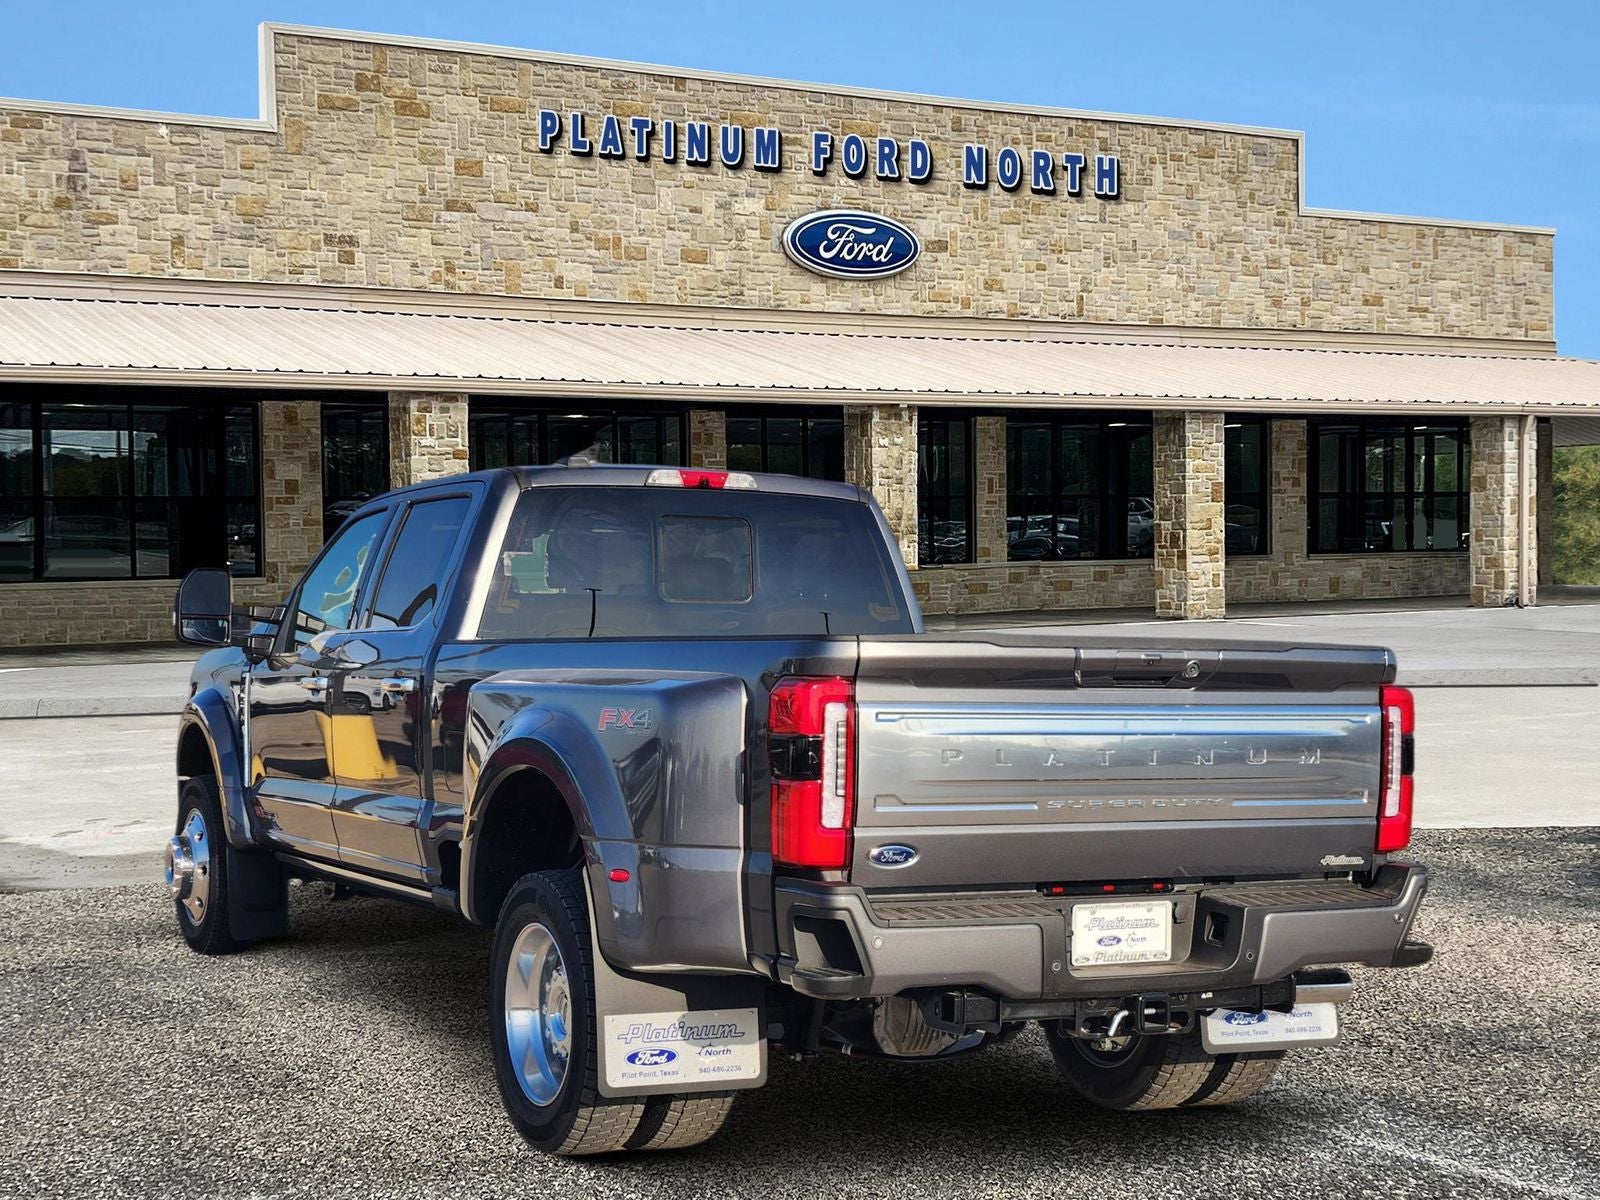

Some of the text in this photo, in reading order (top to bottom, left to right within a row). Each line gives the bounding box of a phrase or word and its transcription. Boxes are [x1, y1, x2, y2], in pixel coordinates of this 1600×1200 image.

[538, 108, 1121, 200] PLATINUM FORD NORTH
[819, 223, 893, 264] Ford
[597, 707, 652, 733] FX4
[941, 748, 1322, 767] PLATINUM
[1290, 1010, 1313, 1019] North
[617, 1020, 745, 1045] Platinum
[634, 1048, 732, 1066] Ford North
[660, 1069, 679, 1077] Texas
